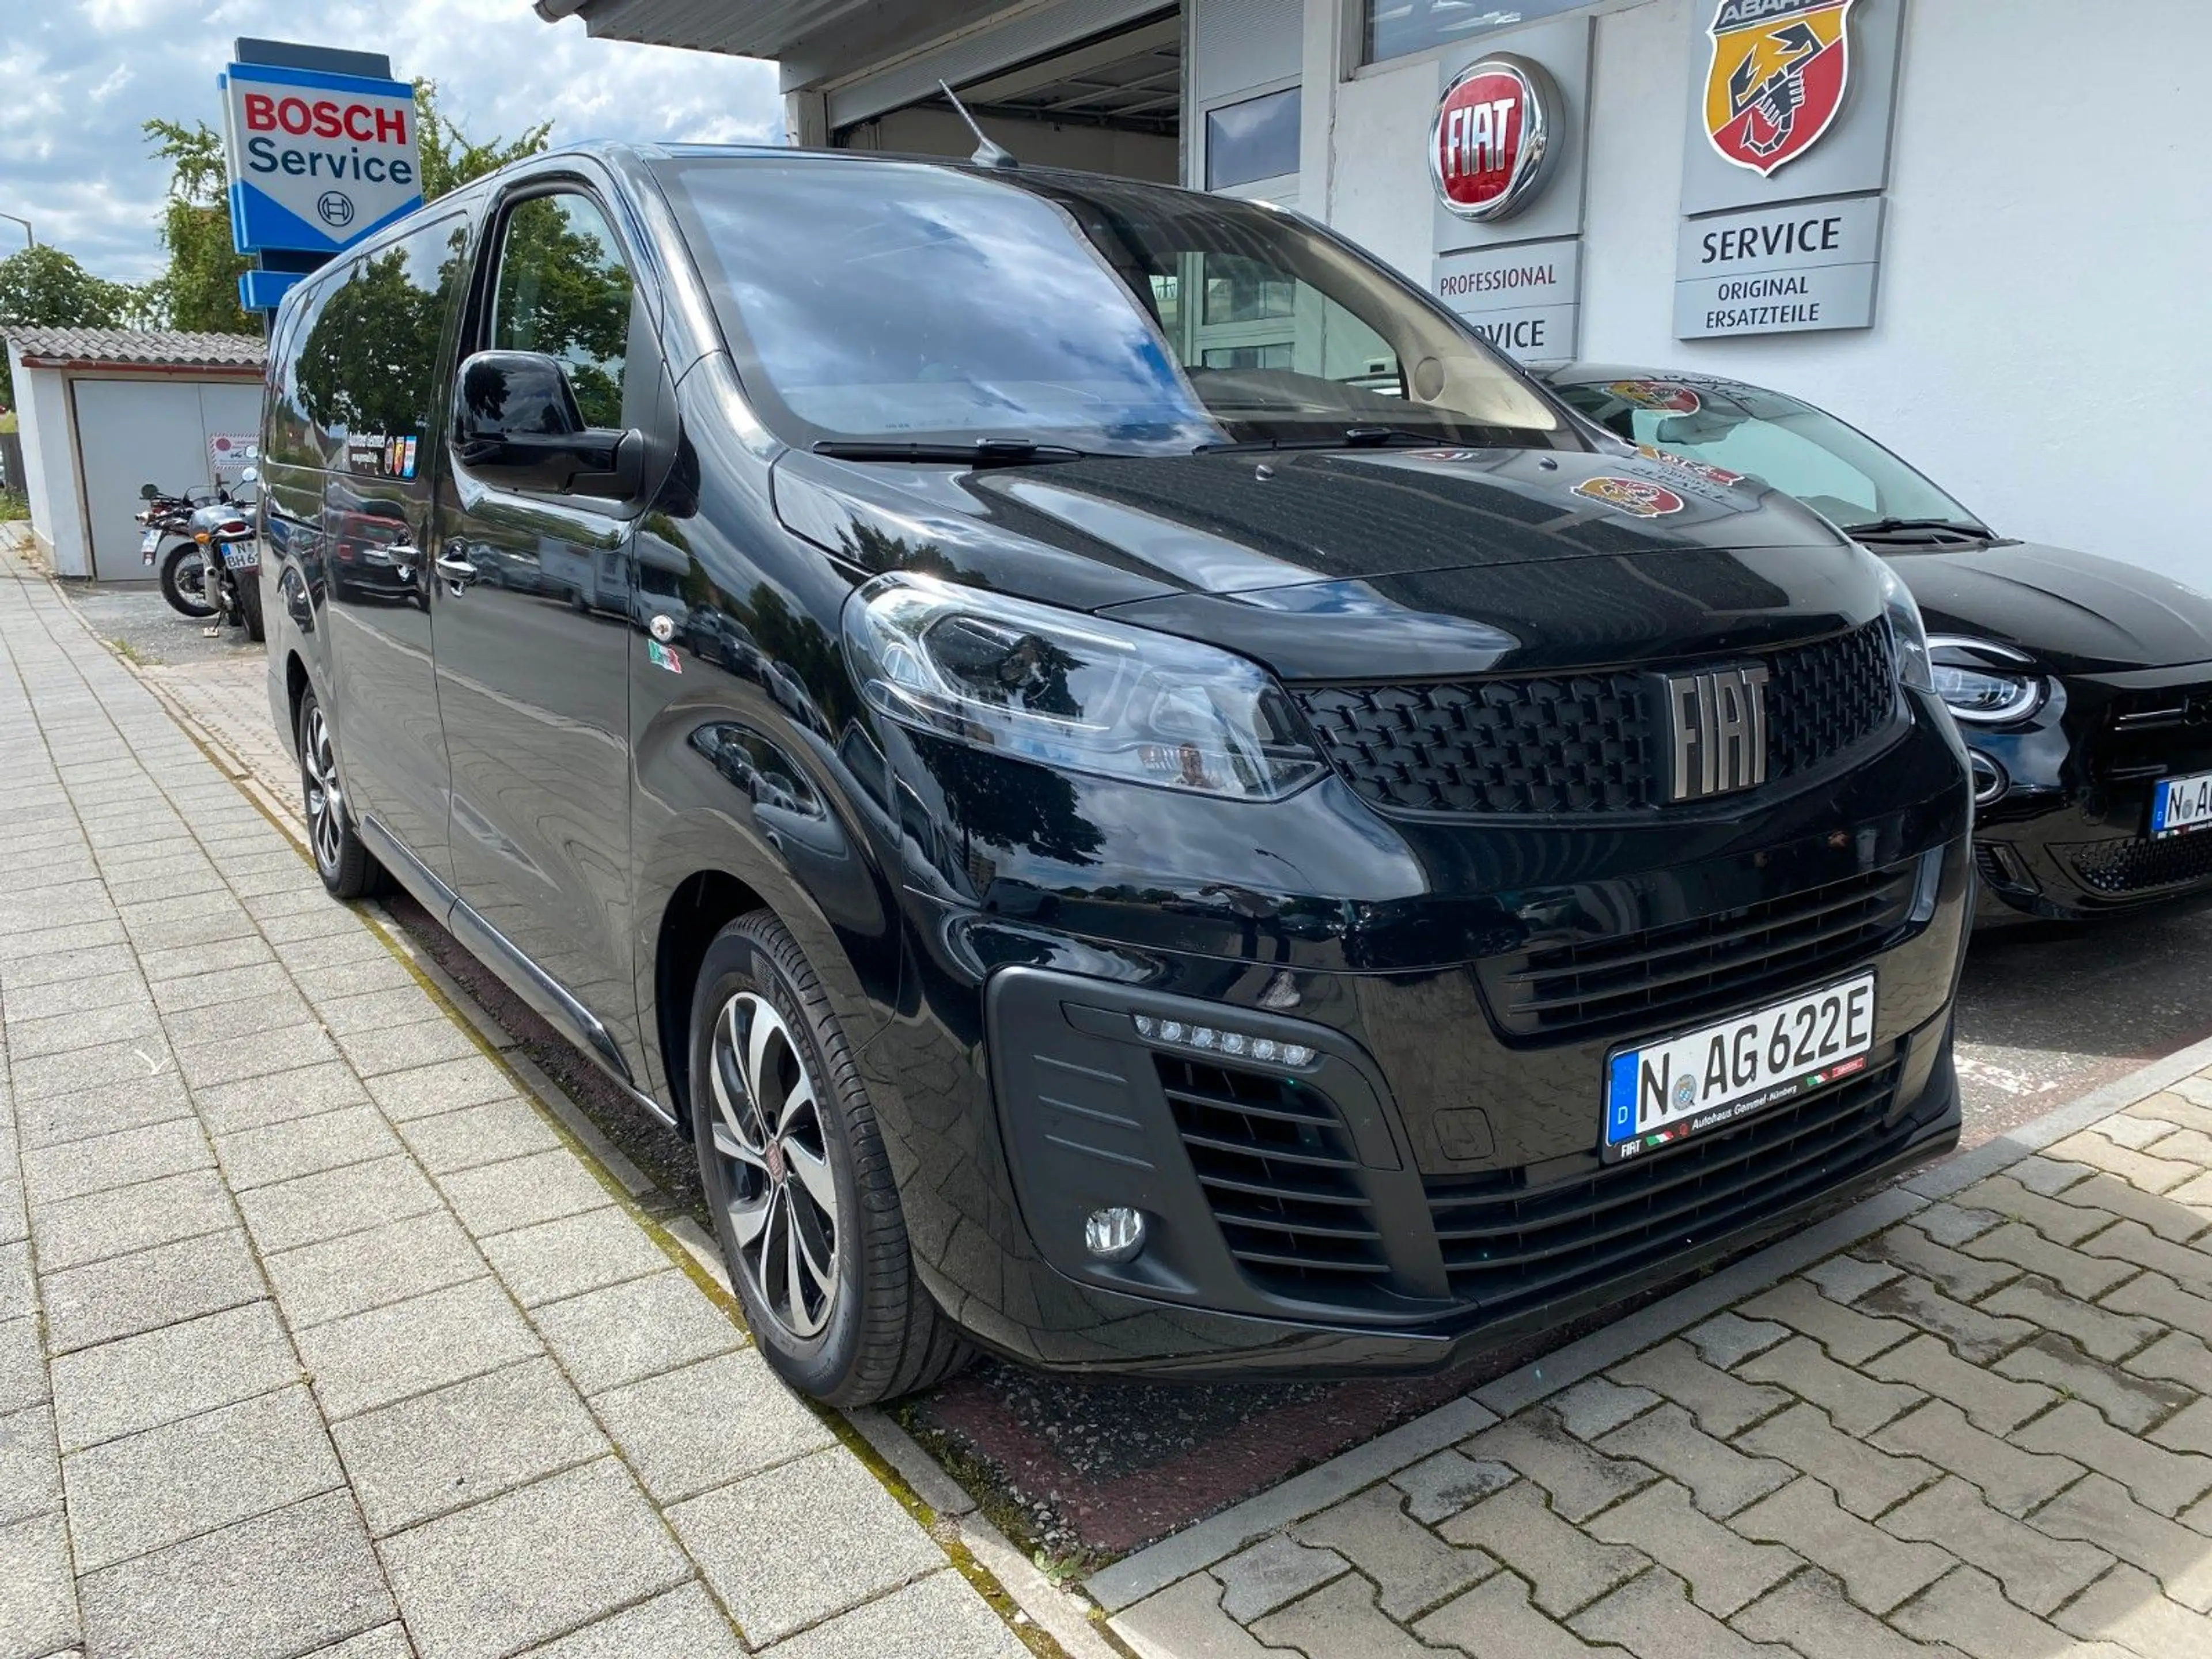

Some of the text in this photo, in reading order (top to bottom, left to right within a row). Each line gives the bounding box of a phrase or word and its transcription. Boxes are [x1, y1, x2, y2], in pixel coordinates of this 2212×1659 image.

[245, 93, 407, 144] BOSCH
[1448, 98, 1516, 179] FIAT
[248, 137, 412, 184] Service
[1702, 217, 1842, 263] SERVICE
[1440, 264, 1556, 296] PROFESSIONAL
[1718, 276, 1809, 301] ORIGINAL
[1706, 303, 1820, 328] ERSATZTEILE
[1473, 320, 1545, 349] VICE
[1669, 666, 1769, 799] FIAT
[2168, 781, 2212, 822] N A
[1639, 986, 1868, 1123] N AG 622E
[1617, 1105, 1628, 1125] D
[1691, 1109, 1732, 1131] Autohaus
[1621, 1139, 1642, 1158] FIAT
